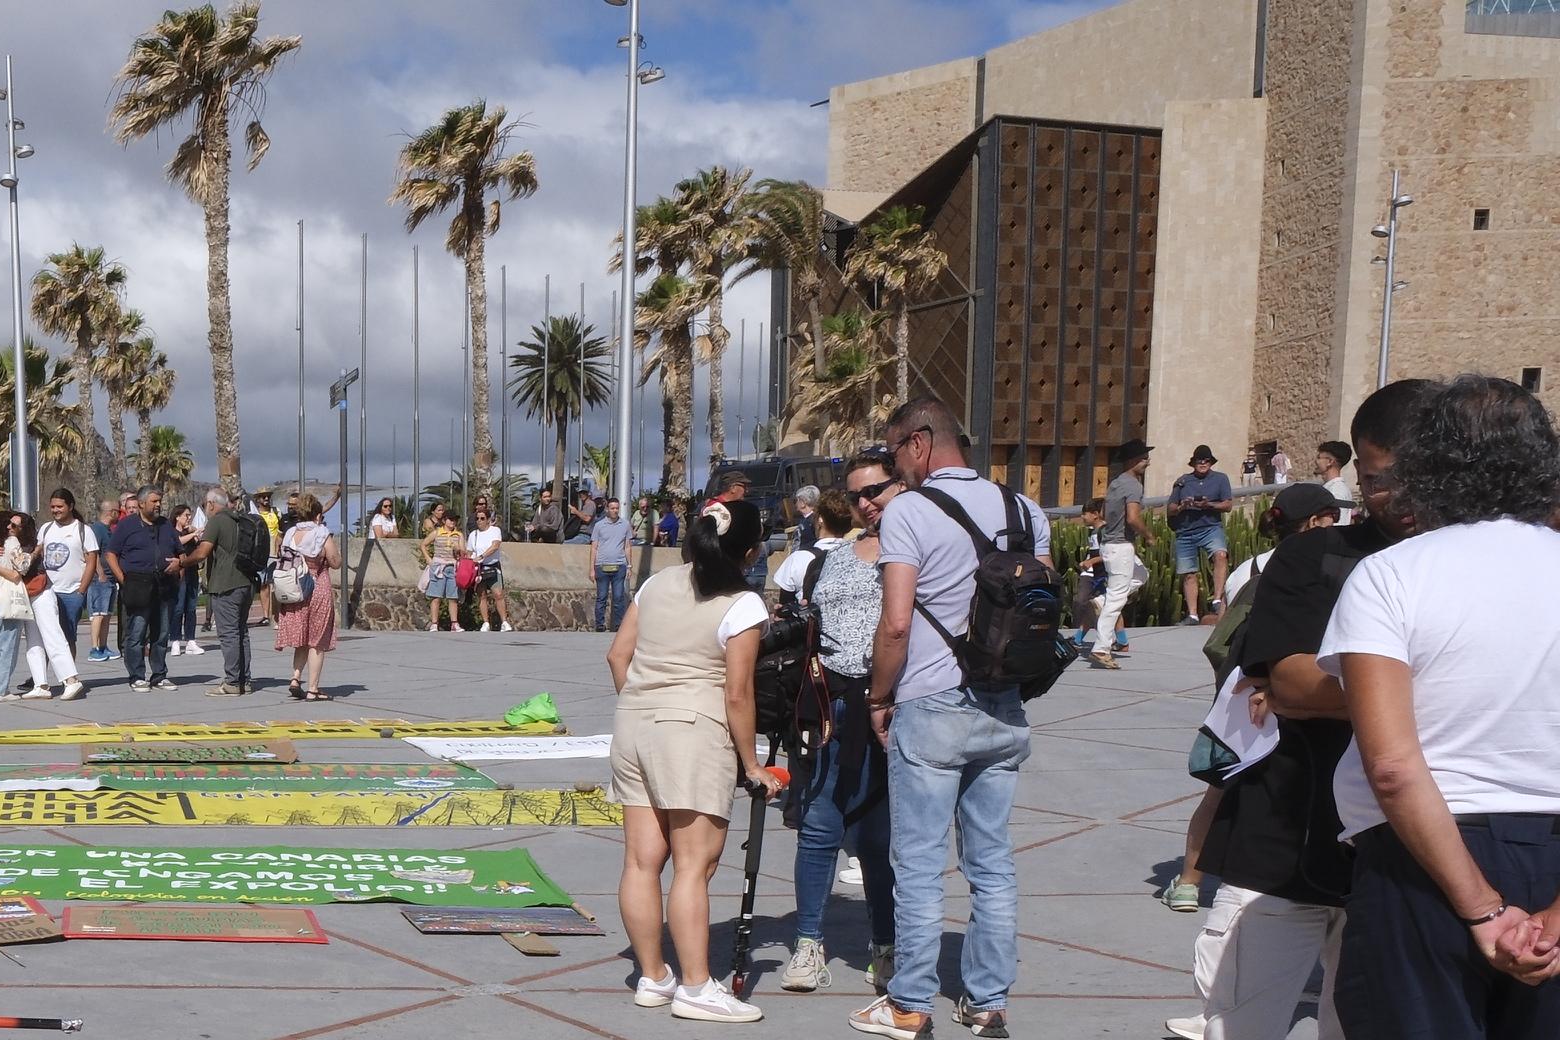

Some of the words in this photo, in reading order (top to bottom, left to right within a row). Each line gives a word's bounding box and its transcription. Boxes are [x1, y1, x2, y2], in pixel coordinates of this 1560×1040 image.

[85, 850, 186, 860] UNA
[210, 852, 467, 864] CANARIAS
[79, 878, 144, 889] EL
